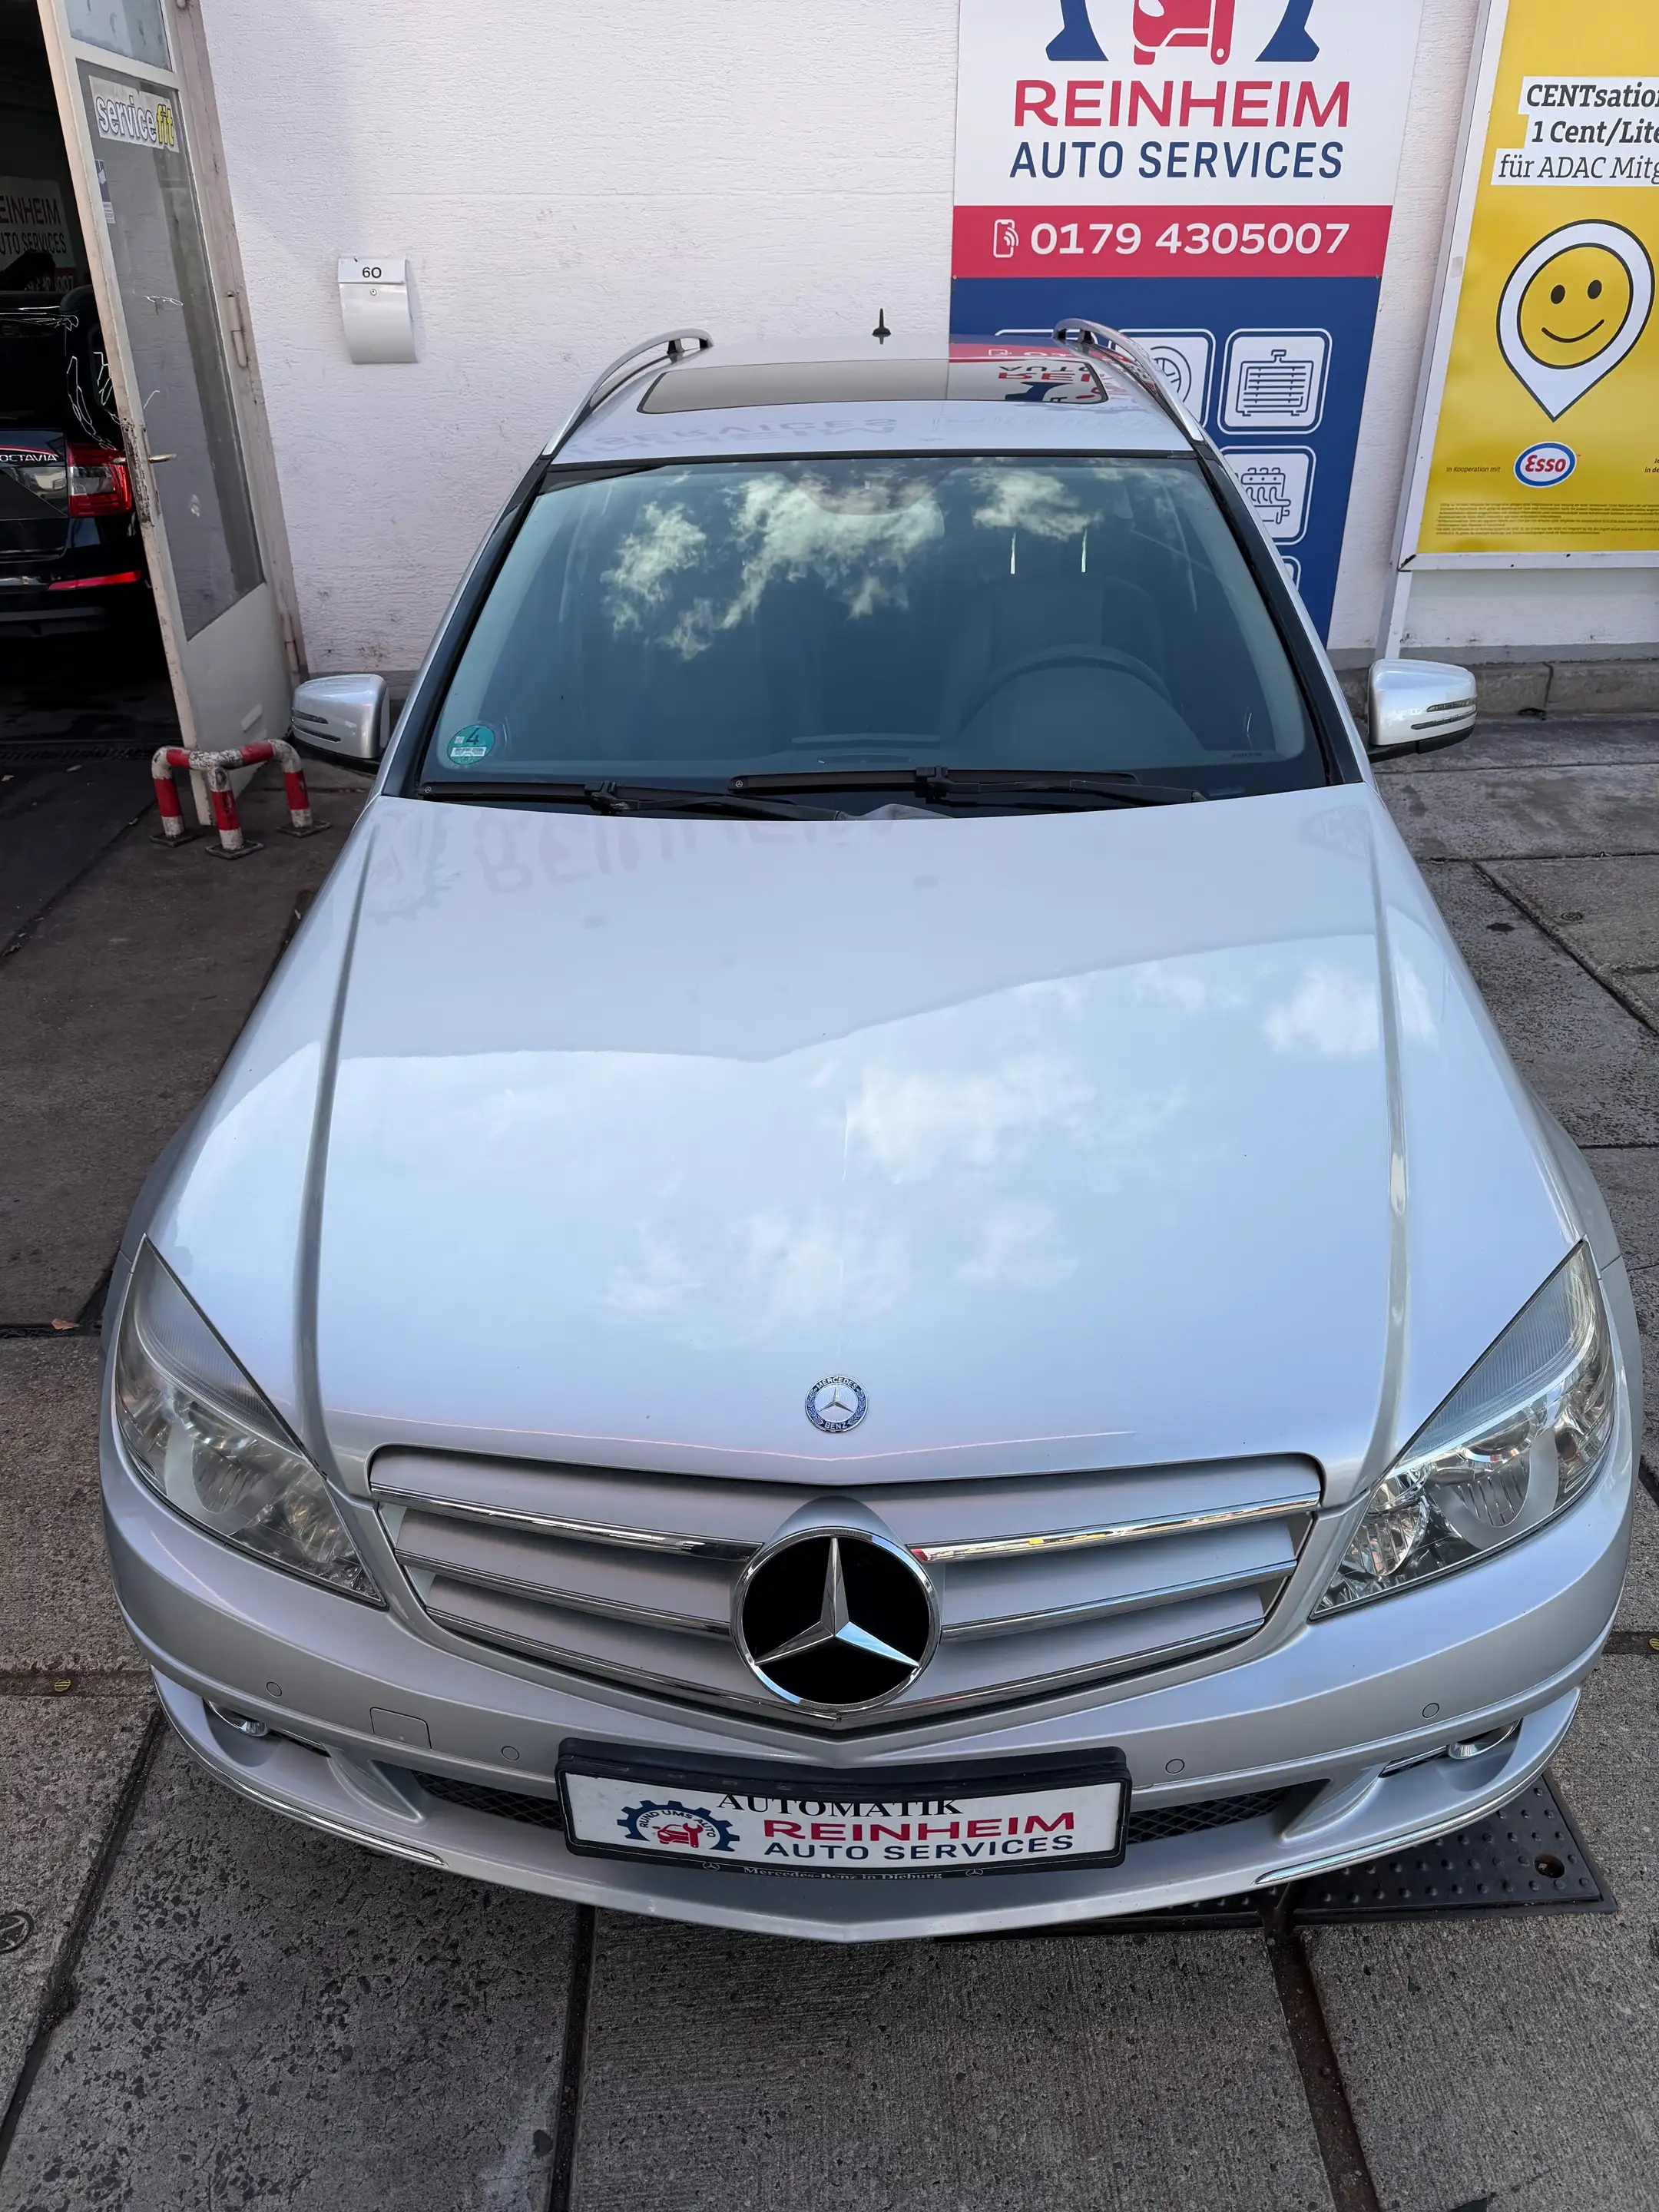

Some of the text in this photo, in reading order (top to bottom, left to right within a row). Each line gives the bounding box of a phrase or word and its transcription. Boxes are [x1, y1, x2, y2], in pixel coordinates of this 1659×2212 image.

[1014, 80, 1350, 127] REINHEIM
[1526, 81, 1659, 108] CENTsatio
[1531, 121, 1544, 143] 1
[1009, 141, 1344, 179] AUTO SERVICES
[1498, 154, 1535, 178] für
[1537, 157, 1607, 179] ADAC
[22, 232, 67, 254] SERVICES
[1030, 223, 1350, 255] 0179 4305007
[362, 267, 382, 279] 60
[0, 454, 58, 462] OCTAVIA
[1525, 454, 1567, 472] Esso
[465, 727, 480, 745] 4
[816, 1376, 858, 1390] MERCEDES
[824, 1422, 848, 1430] BENZ
[717, 1794, 964, 1817] AUTOMATIK
[639, 1810, 717, 1839] RUND UMS AUTO
[763, 1812, 1075, 1842] REINHEIM
[763, 1835, 1074, 1860] AUTO SERVICES
[743, 1866, 856, 1880] Mercedes-Benz
